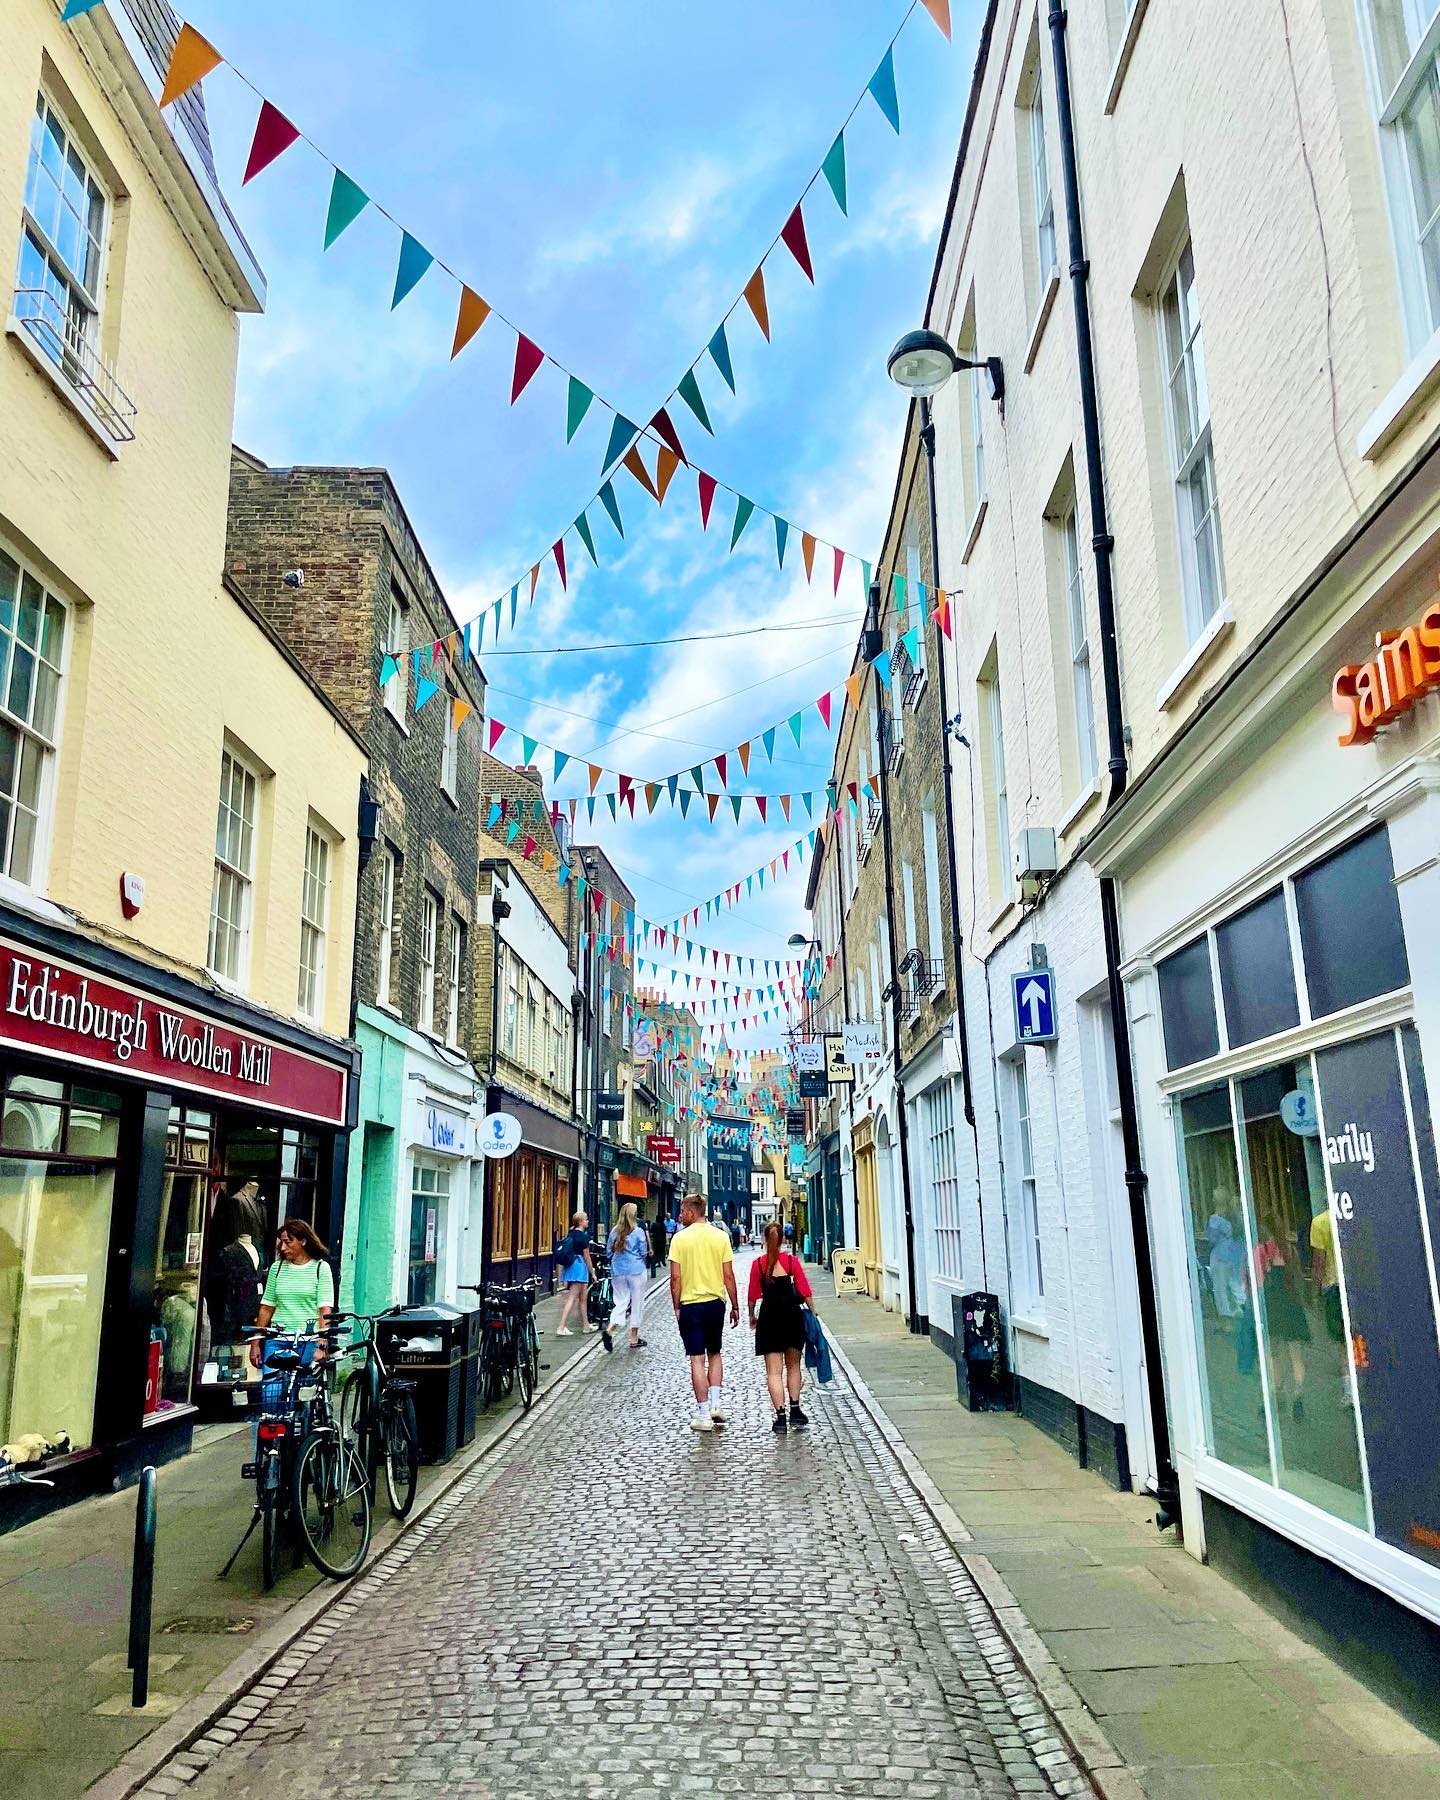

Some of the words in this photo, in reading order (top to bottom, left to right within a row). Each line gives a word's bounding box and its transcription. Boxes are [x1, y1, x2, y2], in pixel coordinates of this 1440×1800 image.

[5, 957, 148, 1061] Edinburgh
[157, 1010, 233, 1077] Woollen
[237, 1040, 272, 1087] Mill
[829, 1043, 845, 1052] Hat
[829, 1064, 851, 1074] Caps
[482, 1140, 513, 1151] Oden
[840, 1258, 857, 1266] Hats
[841, 1276, 859, 1285] Caps
[401, 1354, 427, 1363] Litter
